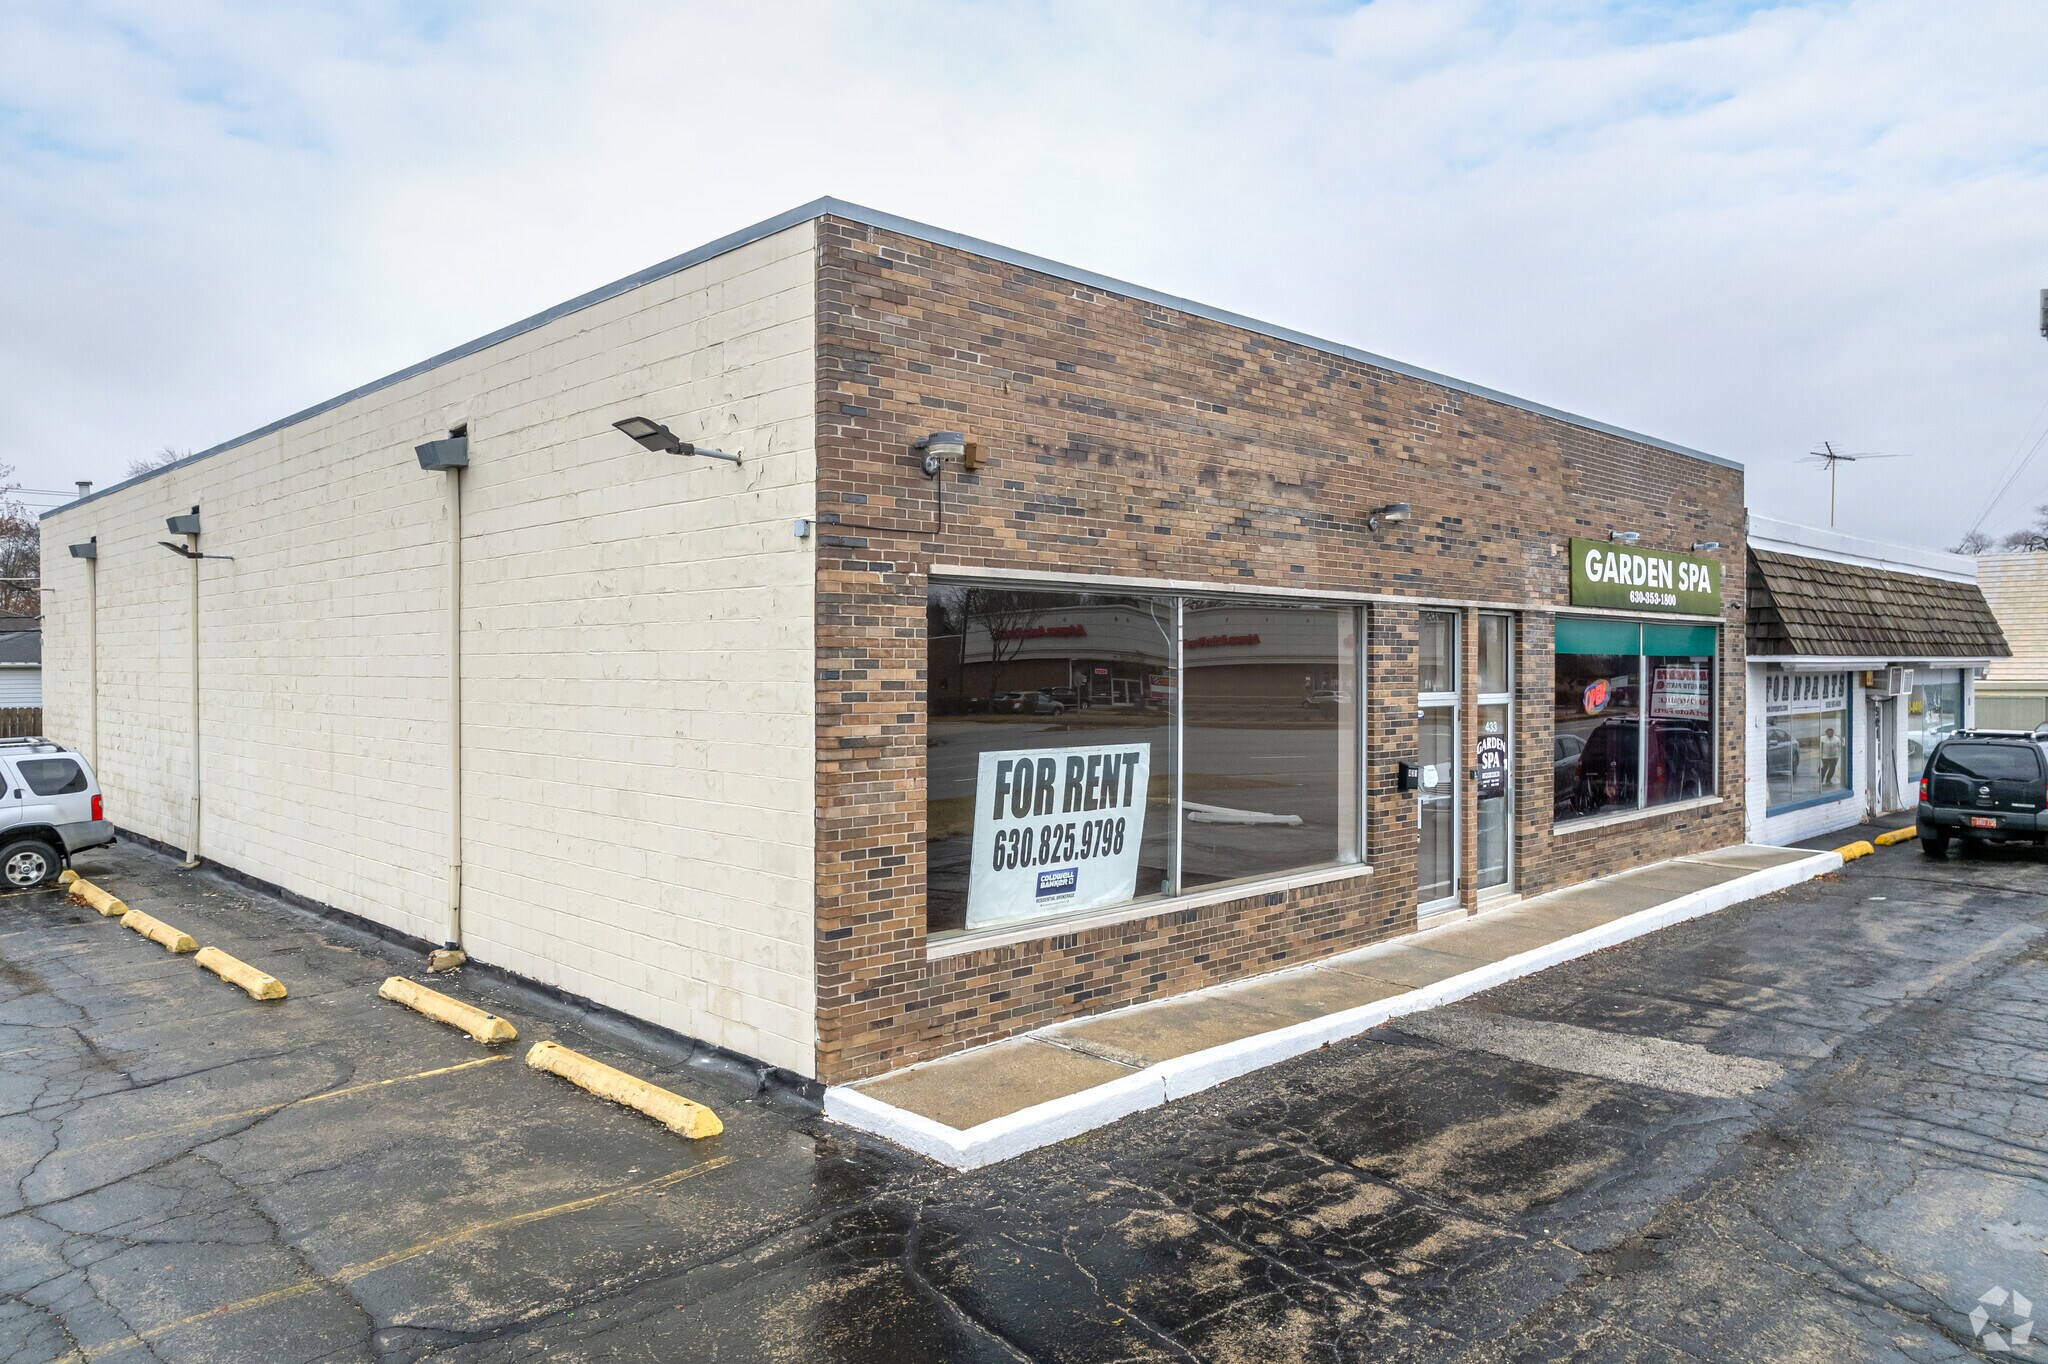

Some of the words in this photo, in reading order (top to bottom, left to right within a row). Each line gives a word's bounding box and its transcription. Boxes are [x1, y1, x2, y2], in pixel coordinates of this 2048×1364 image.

[1585, 548, 1673, 590] GARDEN
[1678, 561, 1712, 594] SPA
[1485, 721, 1498, 732] 433
[1477, 736, 1506, 755] GARDEN
[1482, 751, 1500, 770] SPA
[993, 757, 1057, 820] FOR
[1062, 752, 1140, 814] RENT
[992, 817, 1126, 872] 630.825.9798
